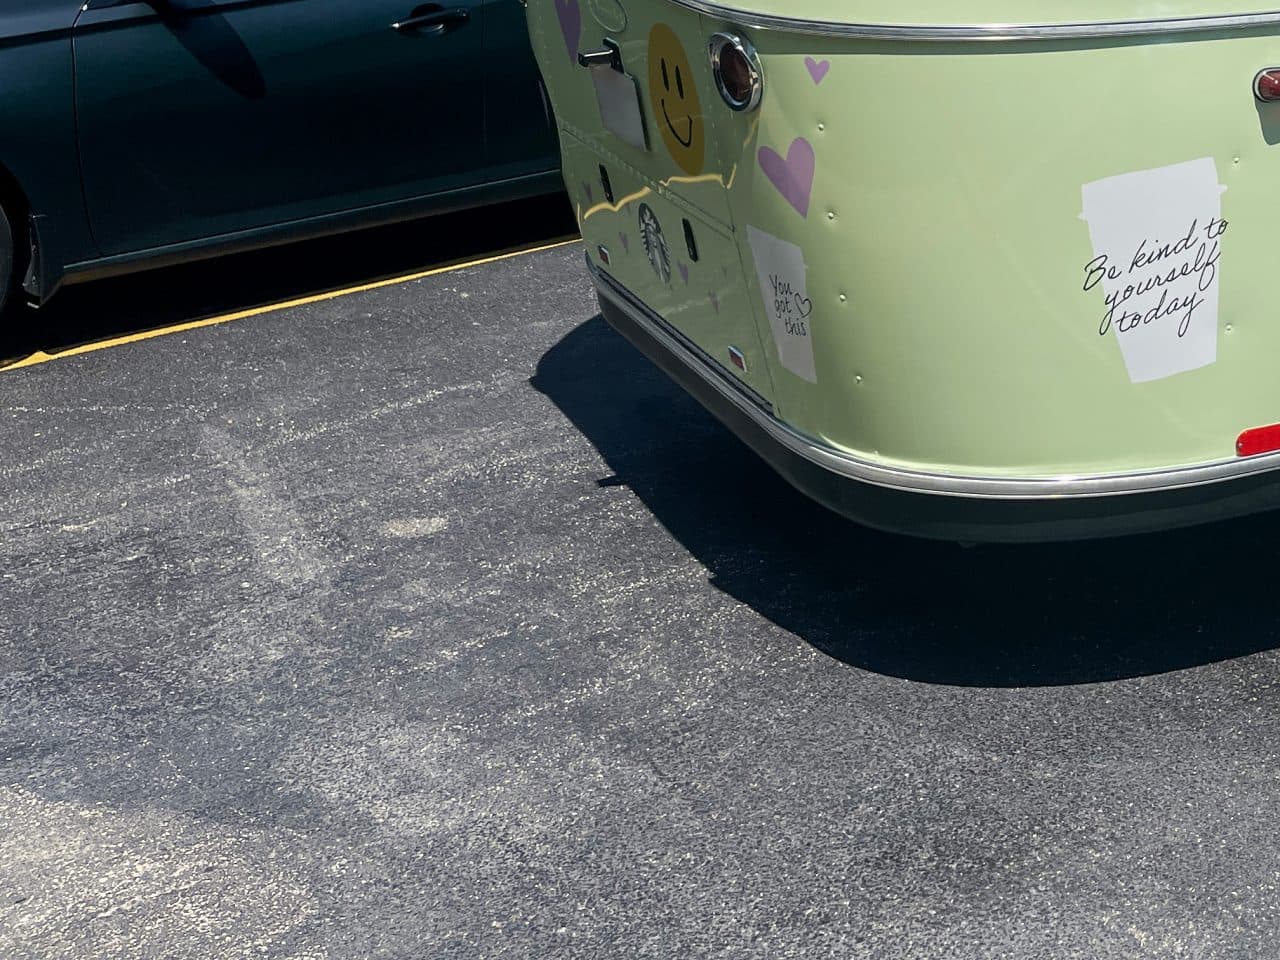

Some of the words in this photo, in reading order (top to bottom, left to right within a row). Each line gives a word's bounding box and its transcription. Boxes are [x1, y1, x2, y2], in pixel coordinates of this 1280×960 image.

[1083, 255, 1122, 291] Be
[1129, 218, 1199, 273] kind
[1203, 217, 1229, 239] to
[769, 274, 793, 297] You
[1099, 241, 1221, 335] yourself
[774, 296, 792, 319] got
[1115, 290, 1204, 337] today
[785, 318, 807, 336] this
